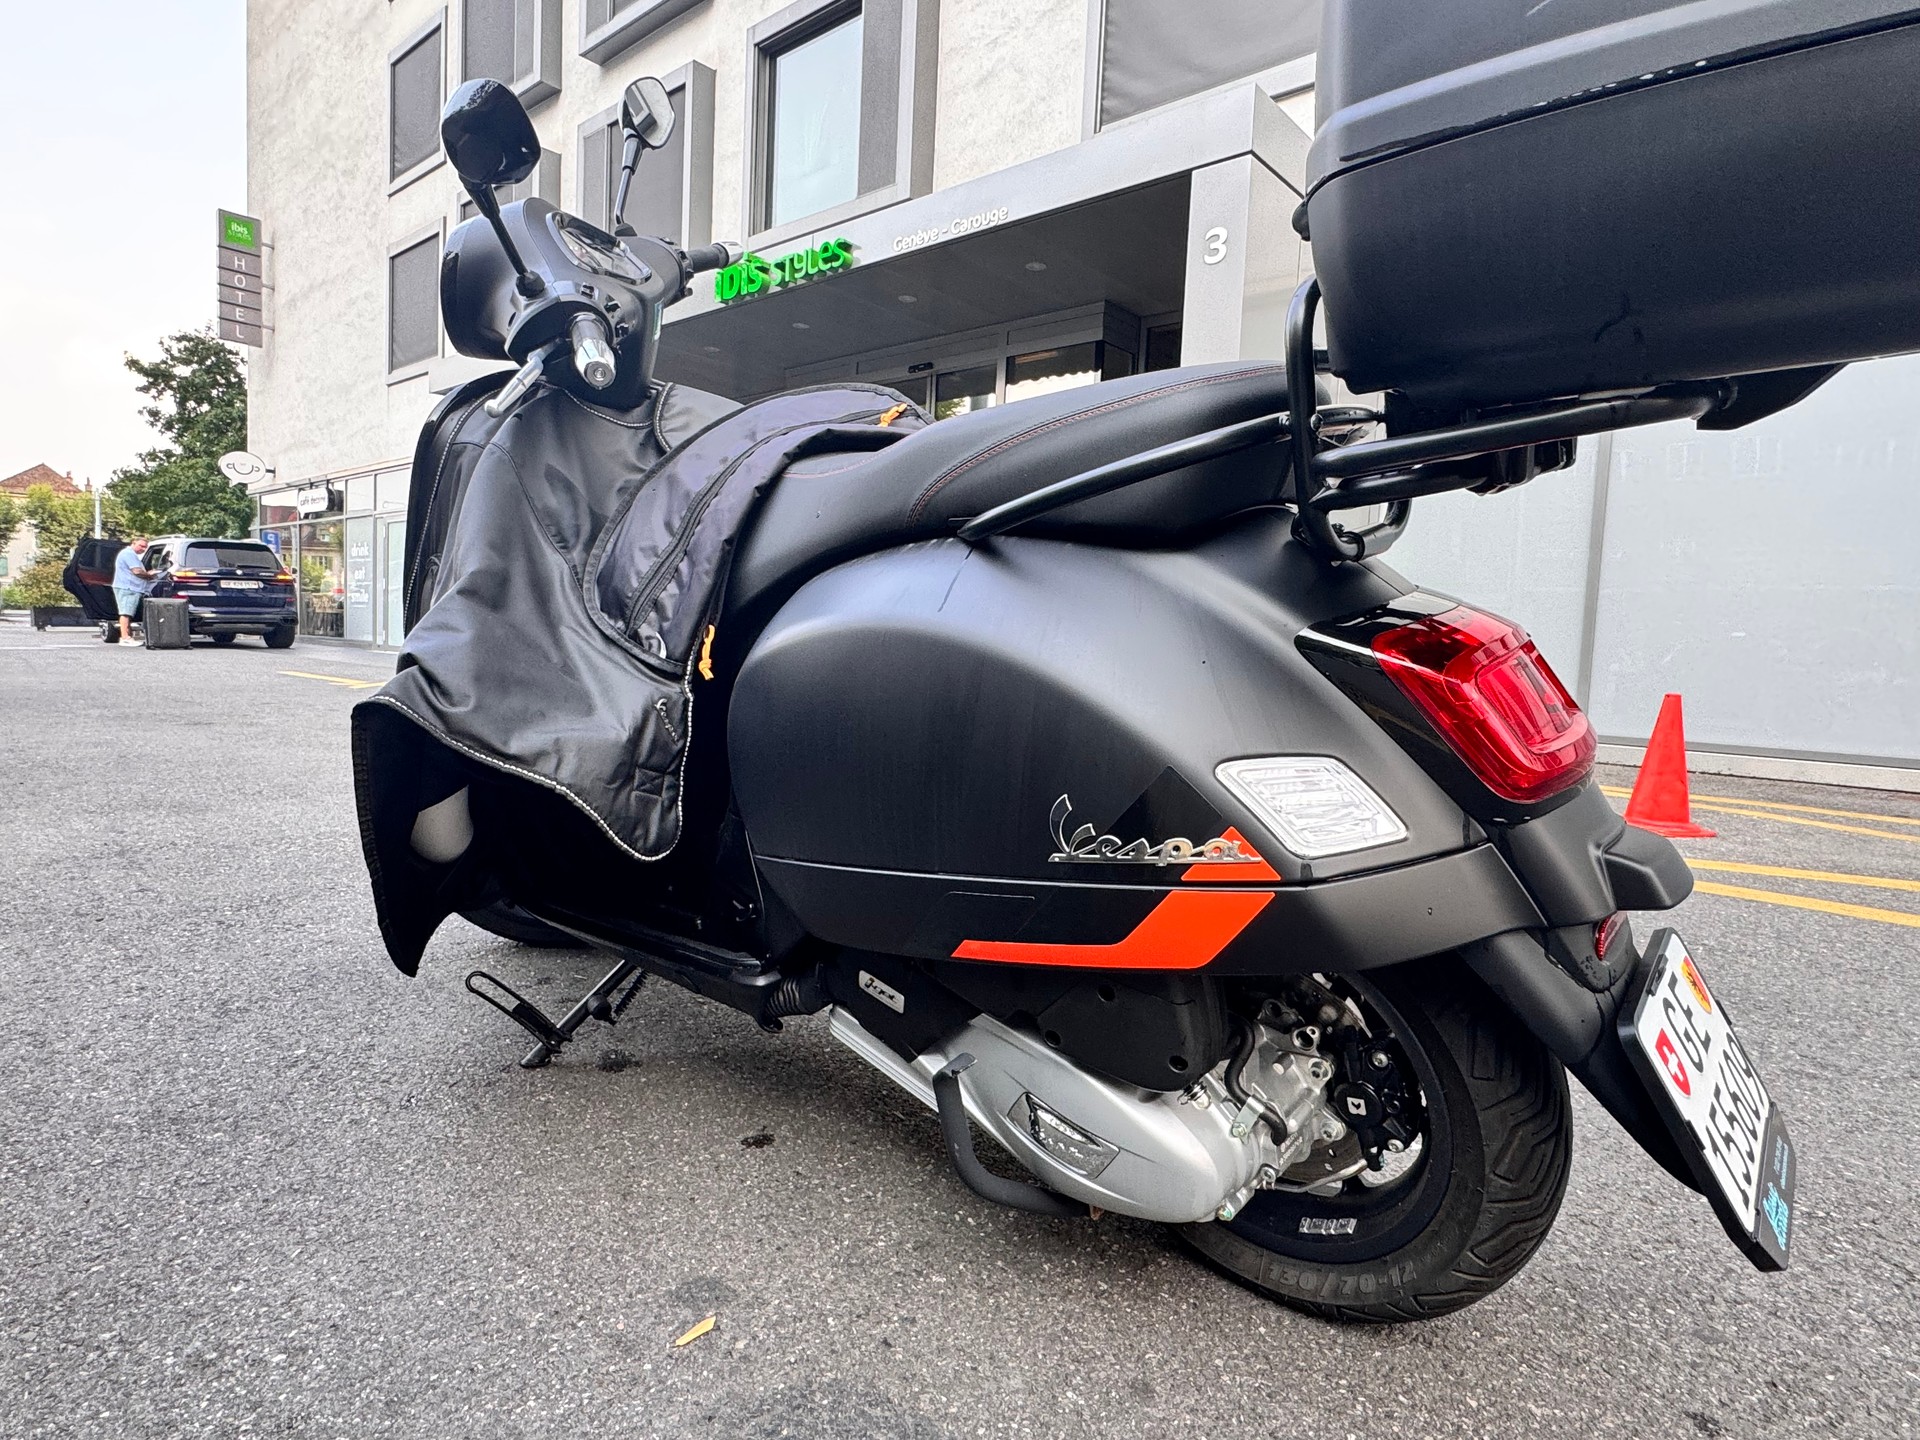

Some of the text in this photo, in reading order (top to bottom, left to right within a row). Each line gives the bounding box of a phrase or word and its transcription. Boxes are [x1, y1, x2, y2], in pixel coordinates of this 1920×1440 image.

[231, 221, 248, 235] ibis
[893, 227, 938, 252] Genève
[950, 206, 1009, 235] Carouge
[1204, 226, 1228, 265] 3
[234, 256, 246, 338] HOTEL
[1048, 794, 1262, 866] Vespa
[1663, 972, 1711, 1073] GE
[1705, 1032, 1766, 1210] 155609
